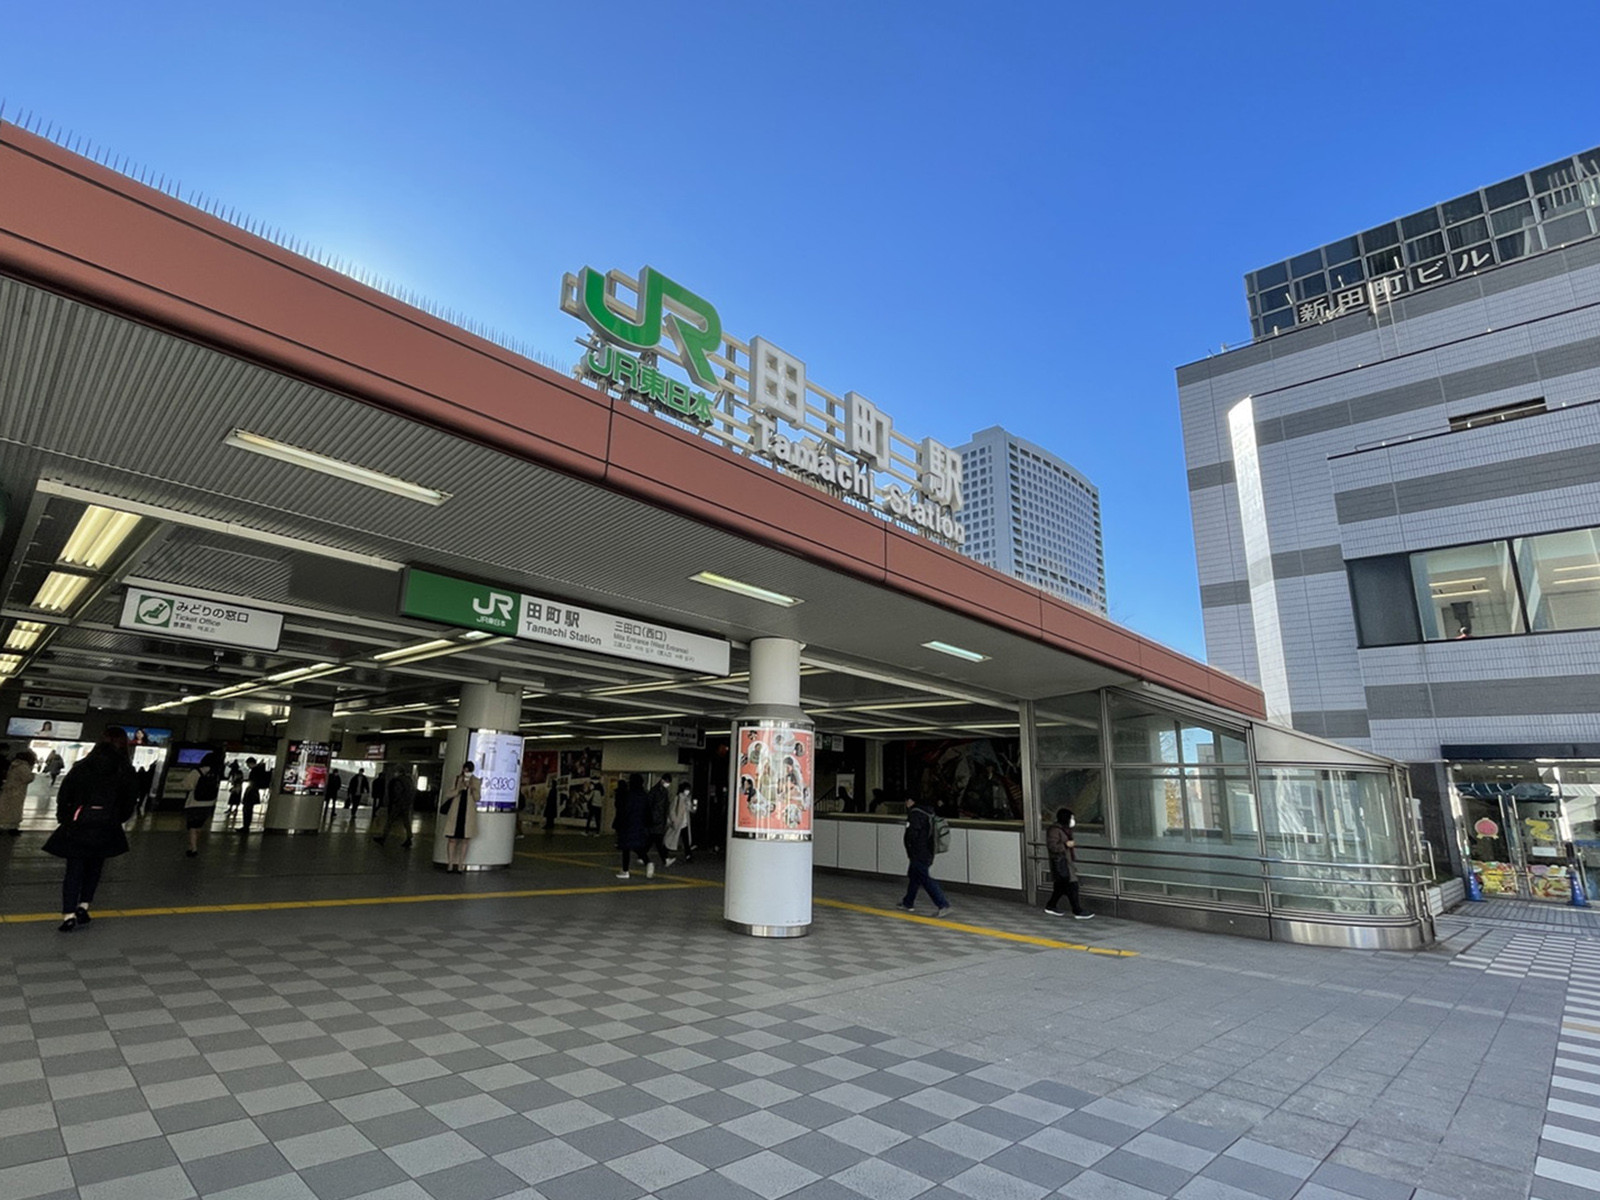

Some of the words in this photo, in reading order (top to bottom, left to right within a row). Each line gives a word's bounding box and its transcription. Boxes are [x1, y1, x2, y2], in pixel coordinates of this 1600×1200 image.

[1299, 249, 1490, 322] 新田町ビル
[583, 264, 722, 391] JR
[588, 345, 714, 423] JR東日本
[750, 336, 963, 512] 田町駅
[754, 414, 875, 501] Tamachi
[889, 482, 965, 545] Station
[175, 613, 198, 623] Ticket
[198, 617, 222, 627] Office
[176, 602, 249, 623] みどりの窓口
[472, 591, 514, 620] JR
[526, 601, 580, 629] 田町駅
[526, 620, 567, 638] Tamachi
[568, 632, 602, 646] Station
